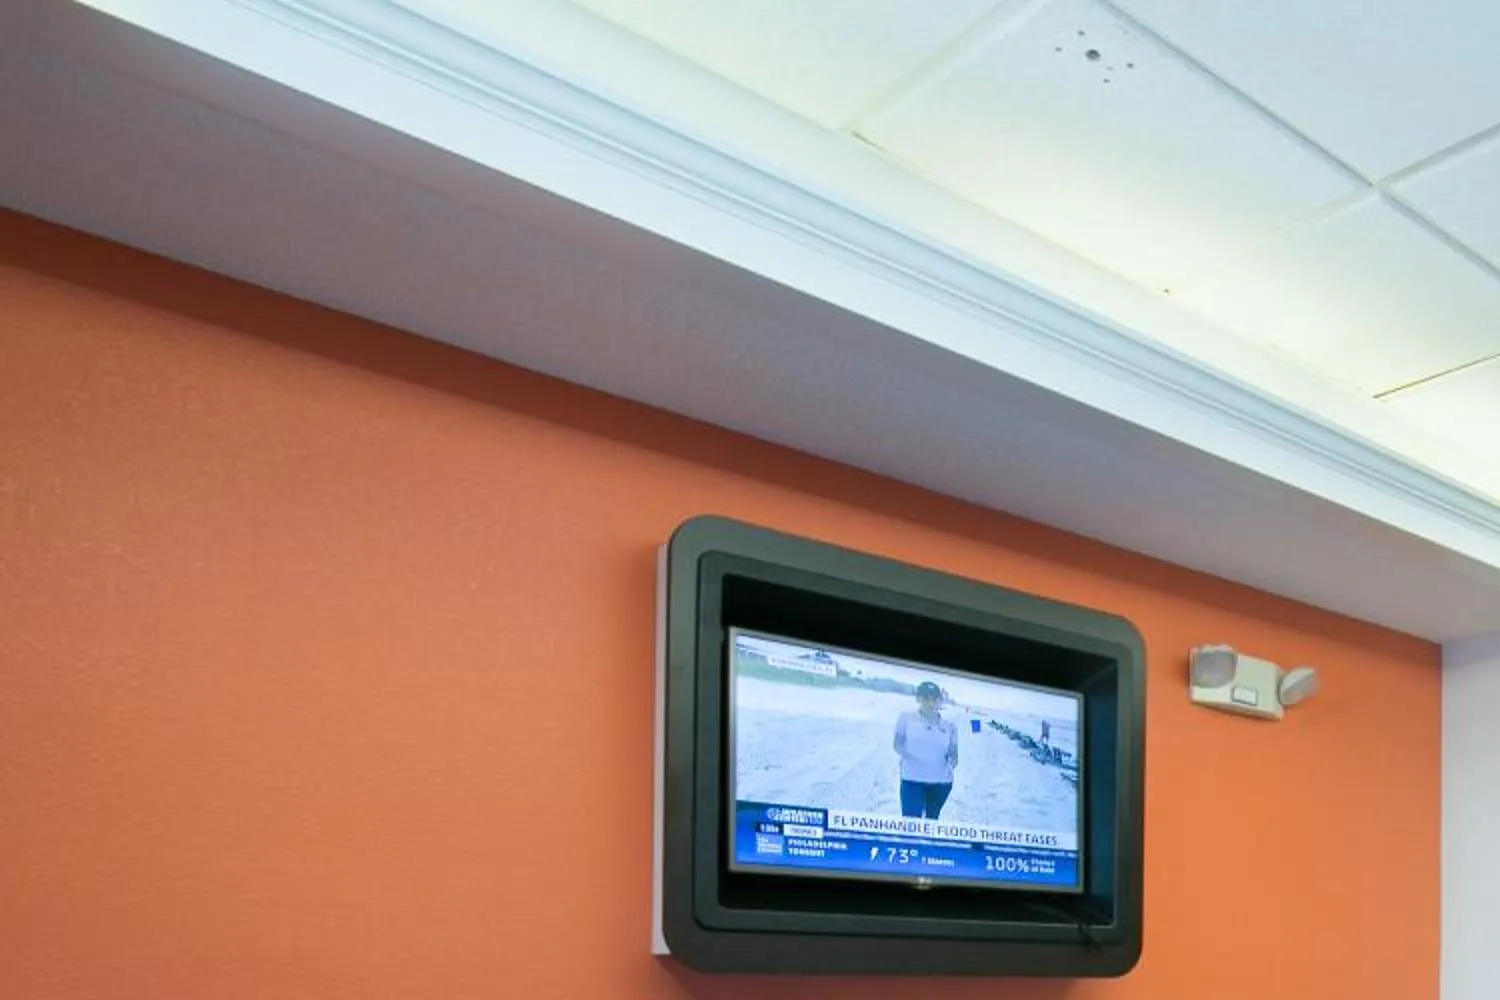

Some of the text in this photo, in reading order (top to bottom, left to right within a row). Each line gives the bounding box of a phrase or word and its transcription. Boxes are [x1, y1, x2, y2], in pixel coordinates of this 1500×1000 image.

[834, 815, 847, 827] FL
[938, 825, 977, 839] FLOOD
[980, 829, 1023, 843] THREAT
[1026, 833, 1058, 847] EASES
[985, 855, 1030, 873] 100%
